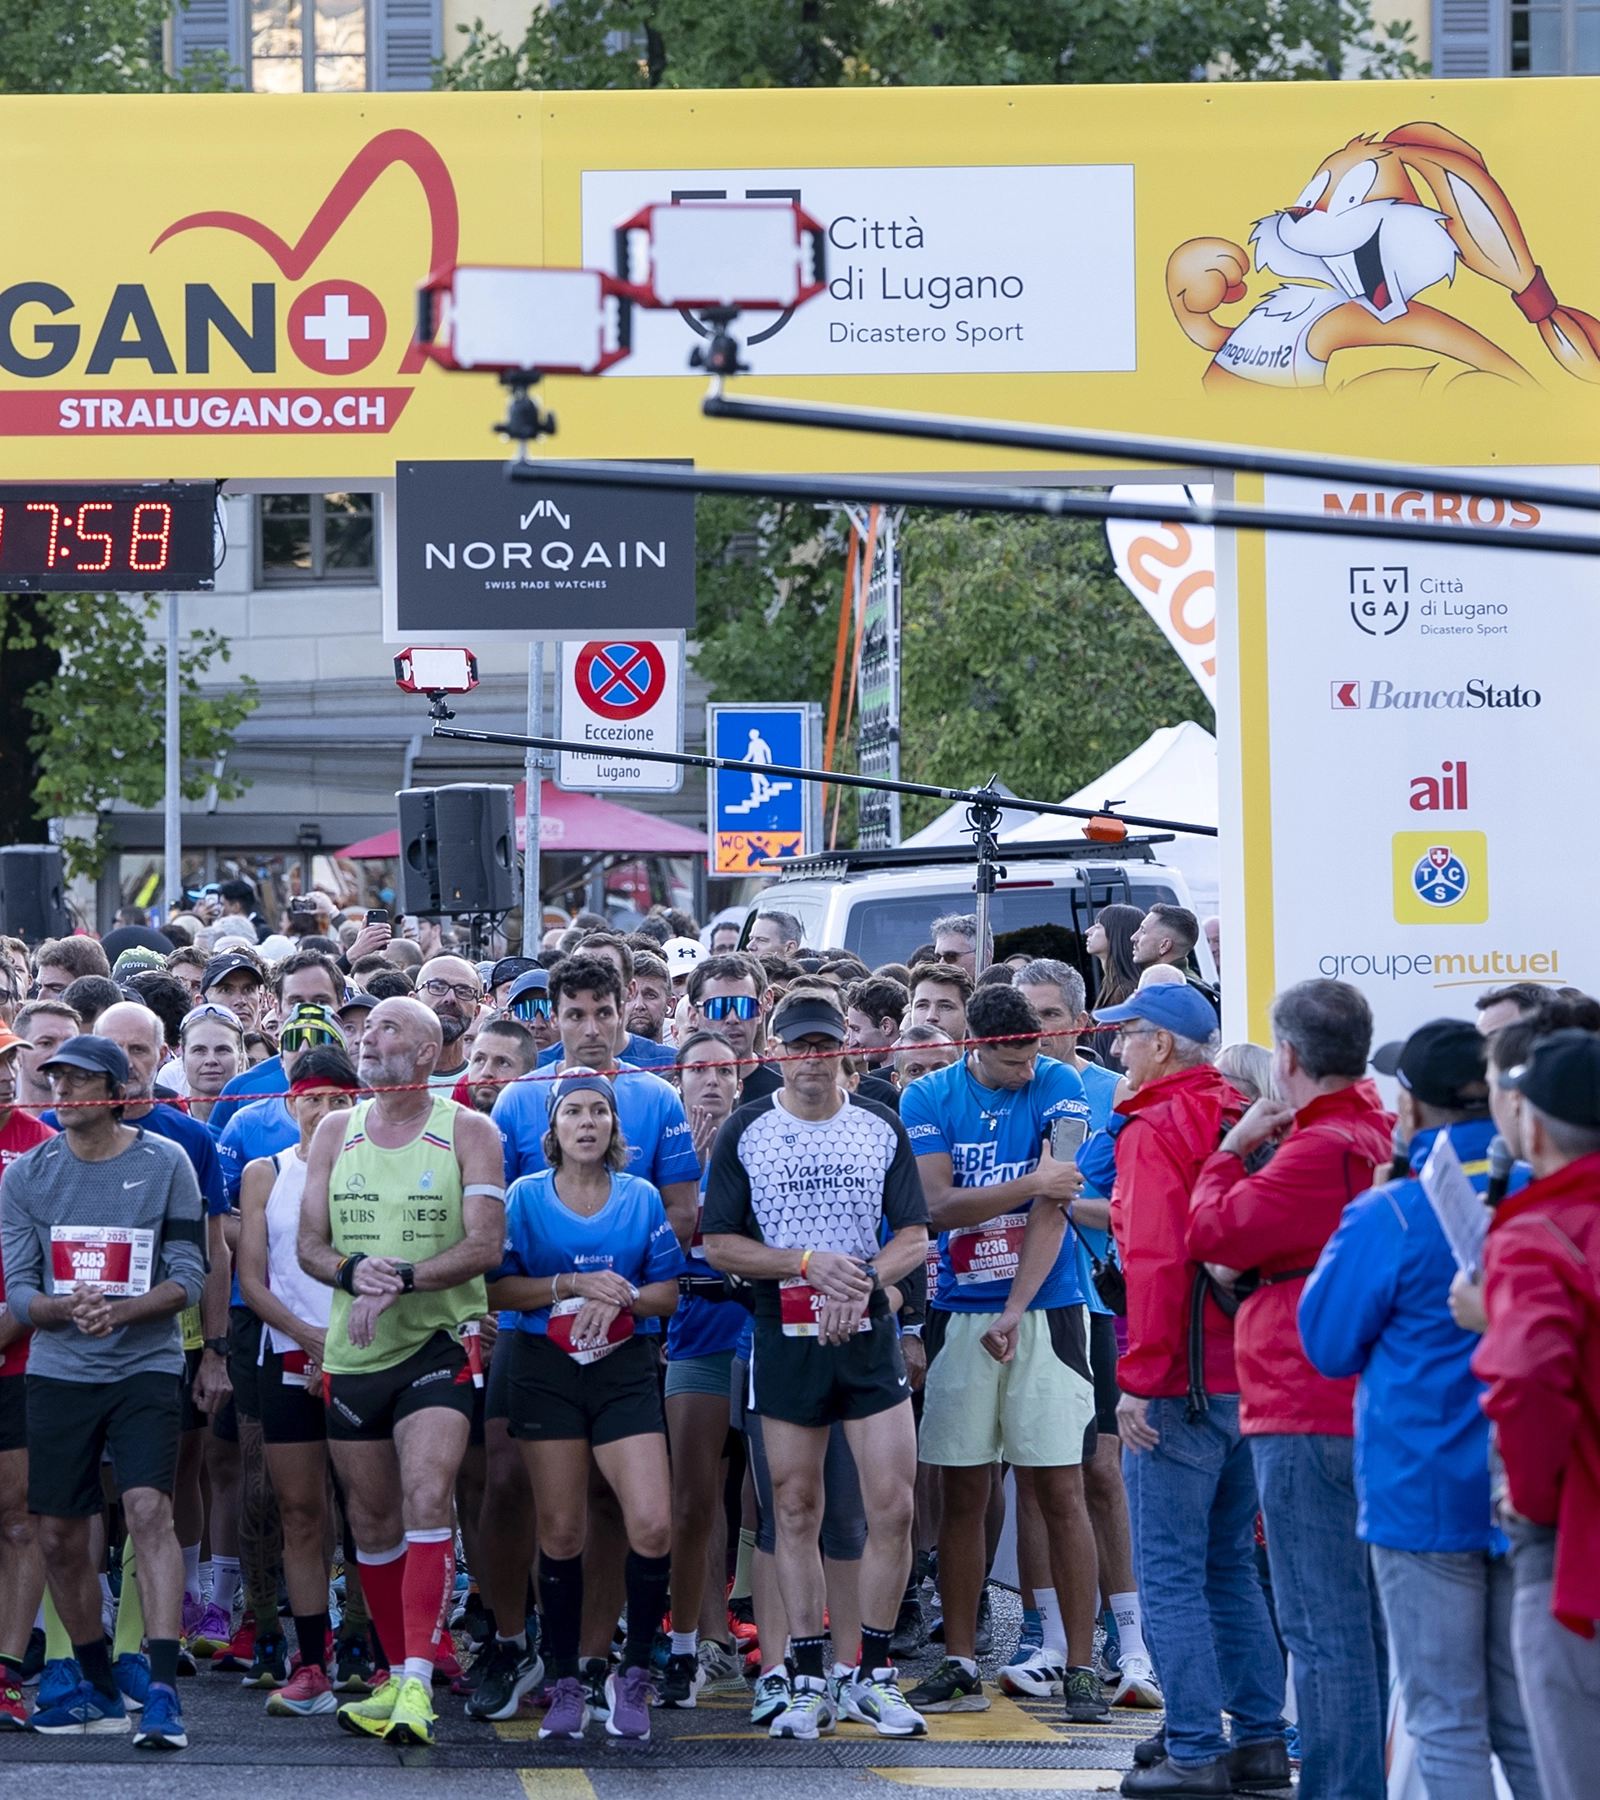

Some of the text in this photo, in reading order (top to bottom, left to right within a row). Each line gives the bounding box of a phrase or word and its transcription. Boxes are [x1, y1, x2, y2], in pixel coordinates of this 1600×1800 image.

[827, 215, 925, 250] Città
[828, 266, 1025, 309] di Lugano
[829, 320, 1025, 347] Dicastero Sport
[58, 394, 386, 429] STRALUGANO.CH
[425, 540, 667, 571] NORQAIN
[485, 580, 607, 590] SWISS MADE WATCHES
[1420, 578, 1464, 594] Città
[1420, 600, 1509, 620] di Lugano
[1420, 623, 1509, 636] Dicastero Sport
[1366, 678, 1542, 710] BancaStato
[584, 724, 655, 742] Eccezione
[596, 764, 642, 781] Lugano
[1409, 761, 1469, 811] ail
[720, 835, 745, 851] WC
[1318, 950, 1559, 981] groupemutuel
[784, 1163, 861, 1179] Varese
[778, 1176, 866, 1194] TRIATHLON
[350, 1209, 376, 1222] UBS
[403, 1209, 447, 1222] INEOS
[107, 1232, 128, 1242] 2025
[974, 1239, 1009, 1257] 4236
[72, 1251, 106, 1269] 2483
[968, 1252, 1019, 1271] RICCARDO
